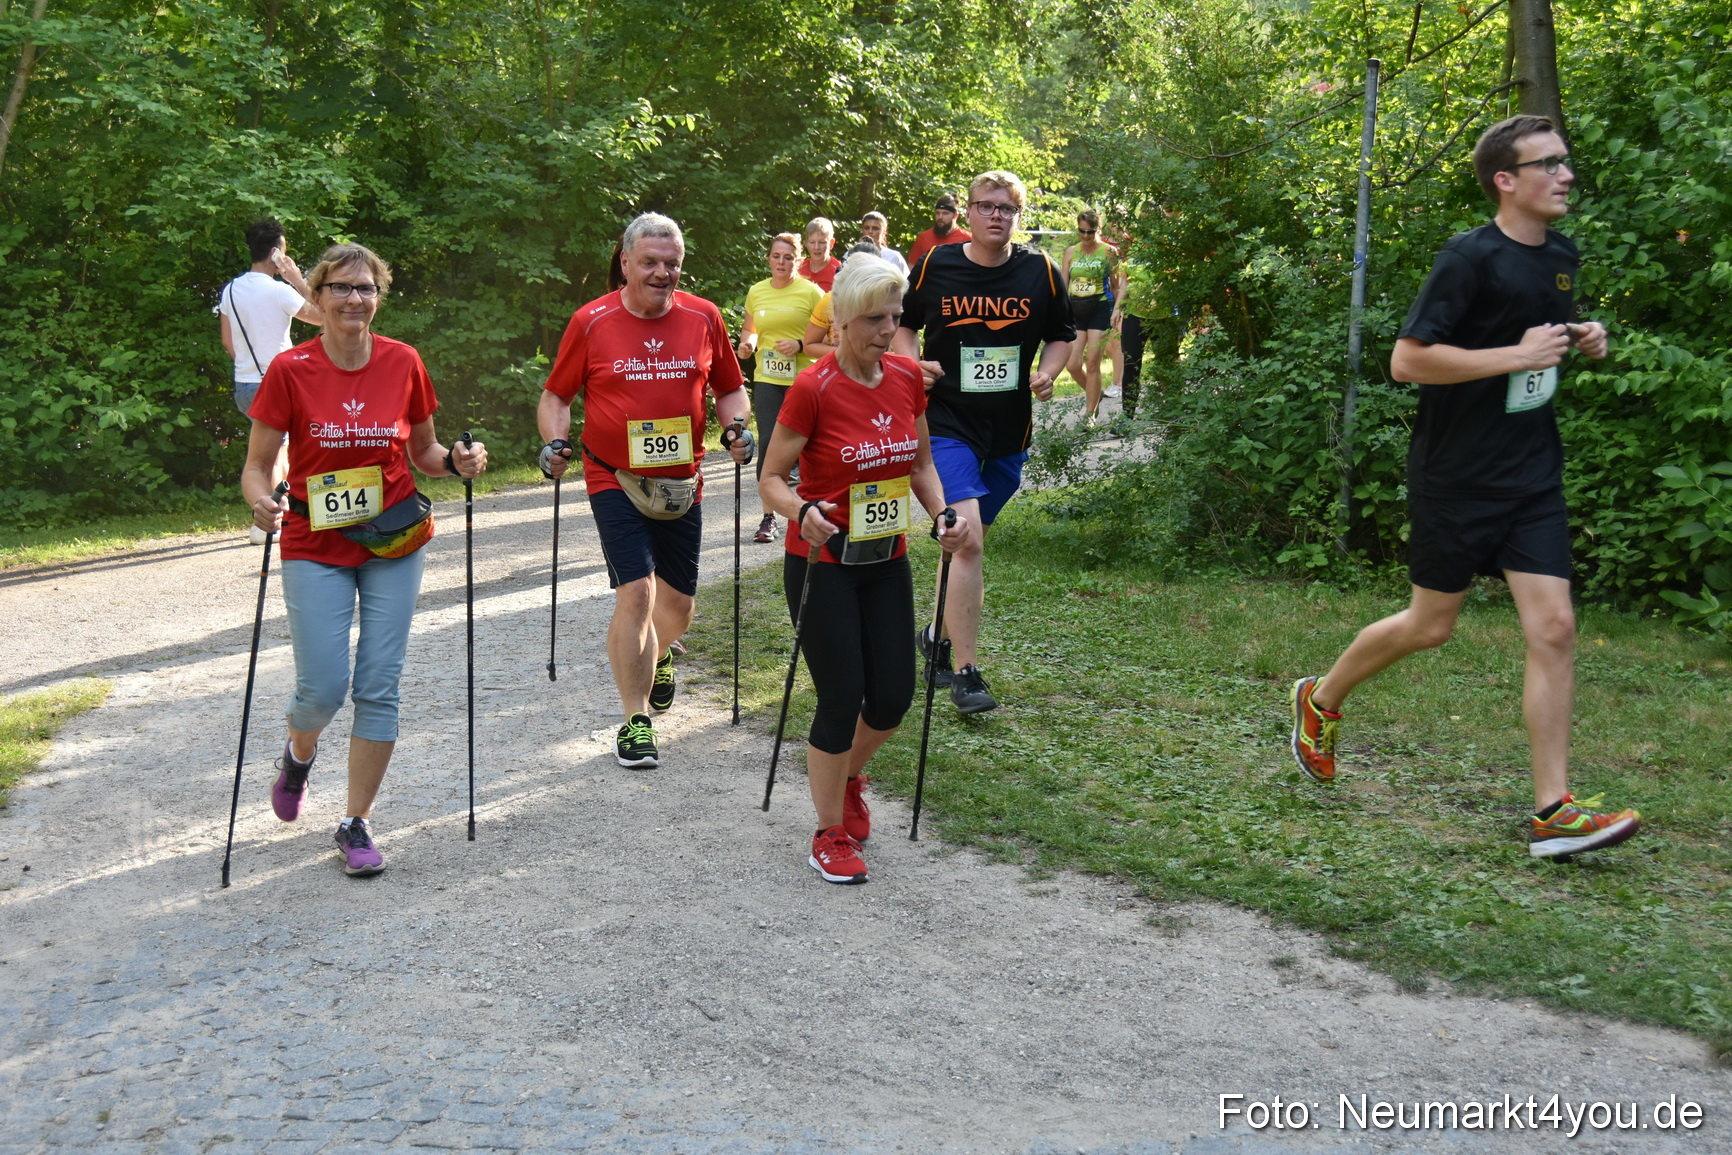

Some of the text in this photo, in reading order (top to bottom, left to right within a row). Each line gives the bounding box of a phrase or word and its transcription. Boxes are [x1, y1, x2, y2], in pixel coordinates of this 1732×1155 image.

[942, 296, 1030, 318] BIT WINGS
[613, 356, 696, 373] Echtes Handwerk
[766, 360, 791, 372] 1304
[974, 363, 1007, 379] 285
[625, 371, 687, 381] IMMER FRISCH
[1527, 372, 1544, 394] 67
[309, 421, 400, 438] Echtes Handwerk
[320, 440, 351, 448] IMMER
[644, 435, 679, 454] 596
[841, 441, 881, 463] Echtes
[857, 458, 887, 471] IMMER
[325, 488, 368, 512] 614
[865, 499, 898, 524] 593
